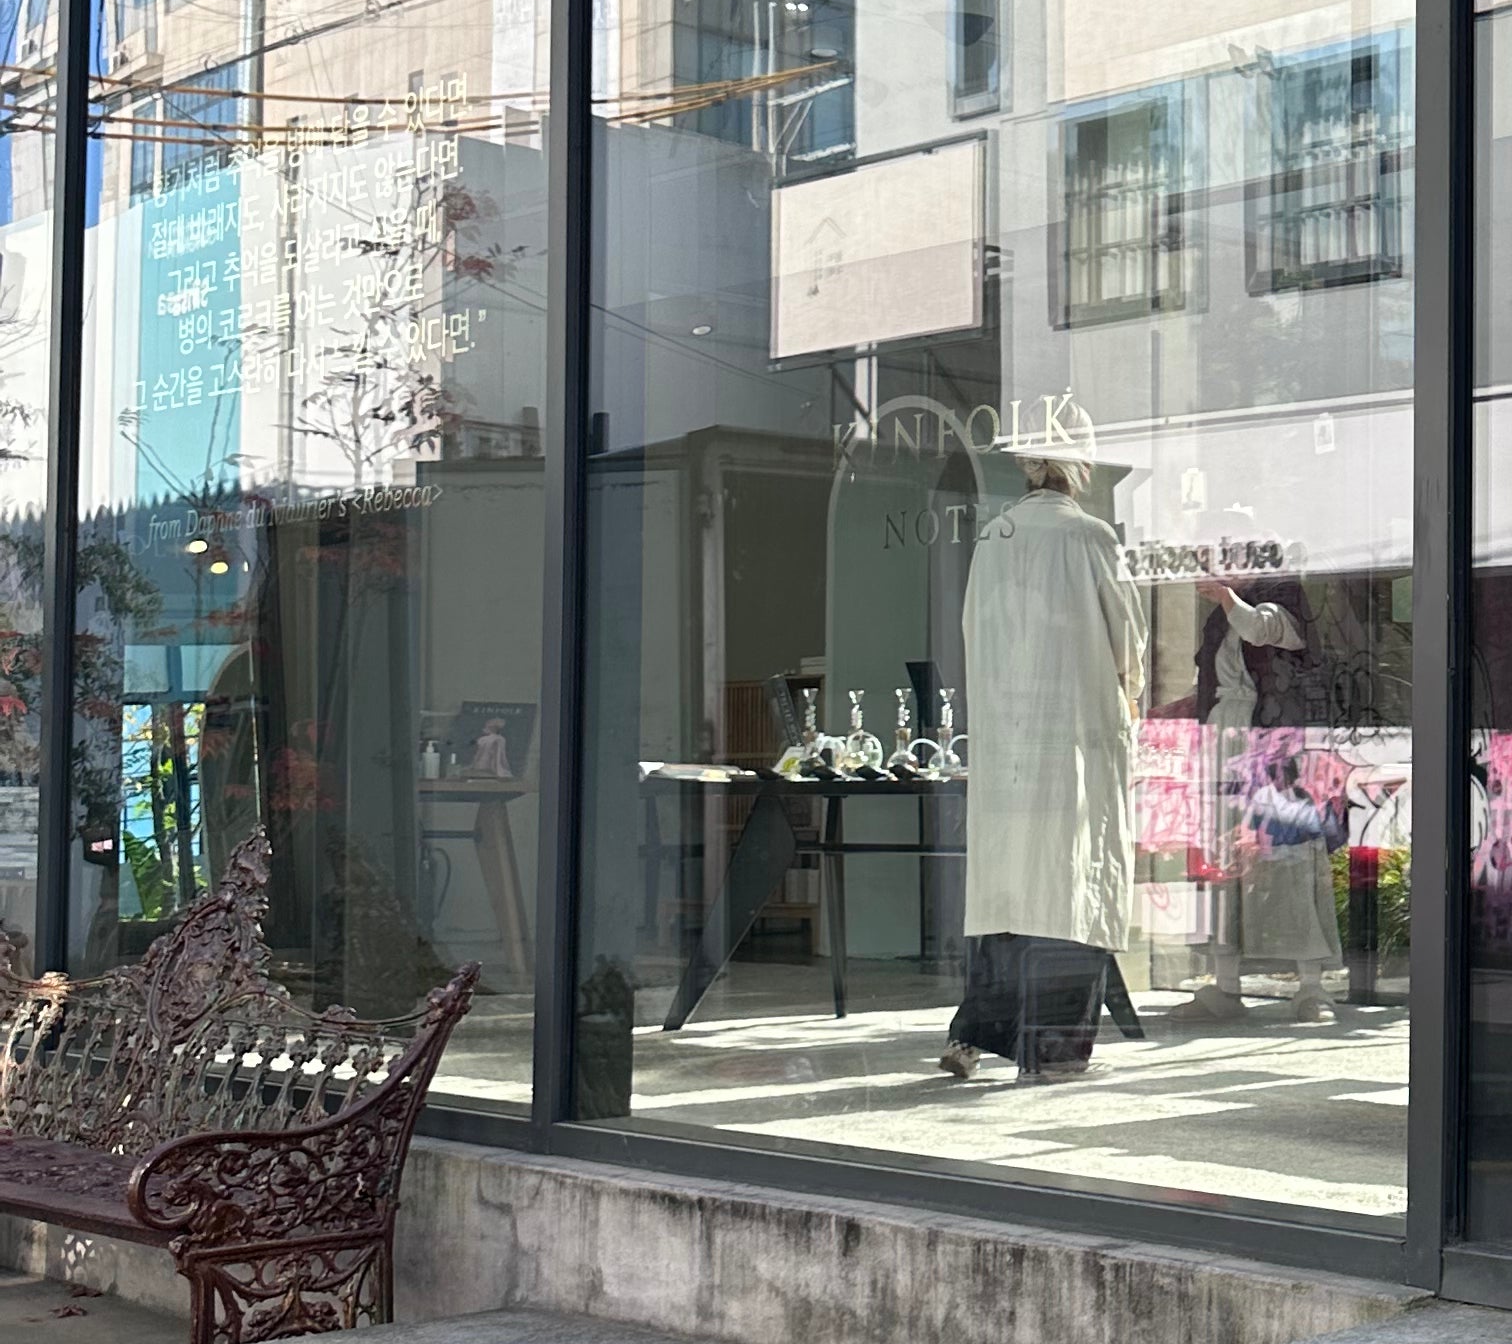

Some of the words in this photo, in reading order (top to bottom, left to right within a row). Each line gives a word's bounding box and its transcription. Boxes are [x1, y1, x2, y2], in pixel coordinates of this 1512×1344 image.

[377, 97, 398, 141] 수
[178, 311, 213, 356] 병의
[152, 365, 203, 413] 순간을
[831, 393, 1077, 472] KINFOLK
[148, 513, 182, 549] from
[884, 501, 1017, 550] NOTES
